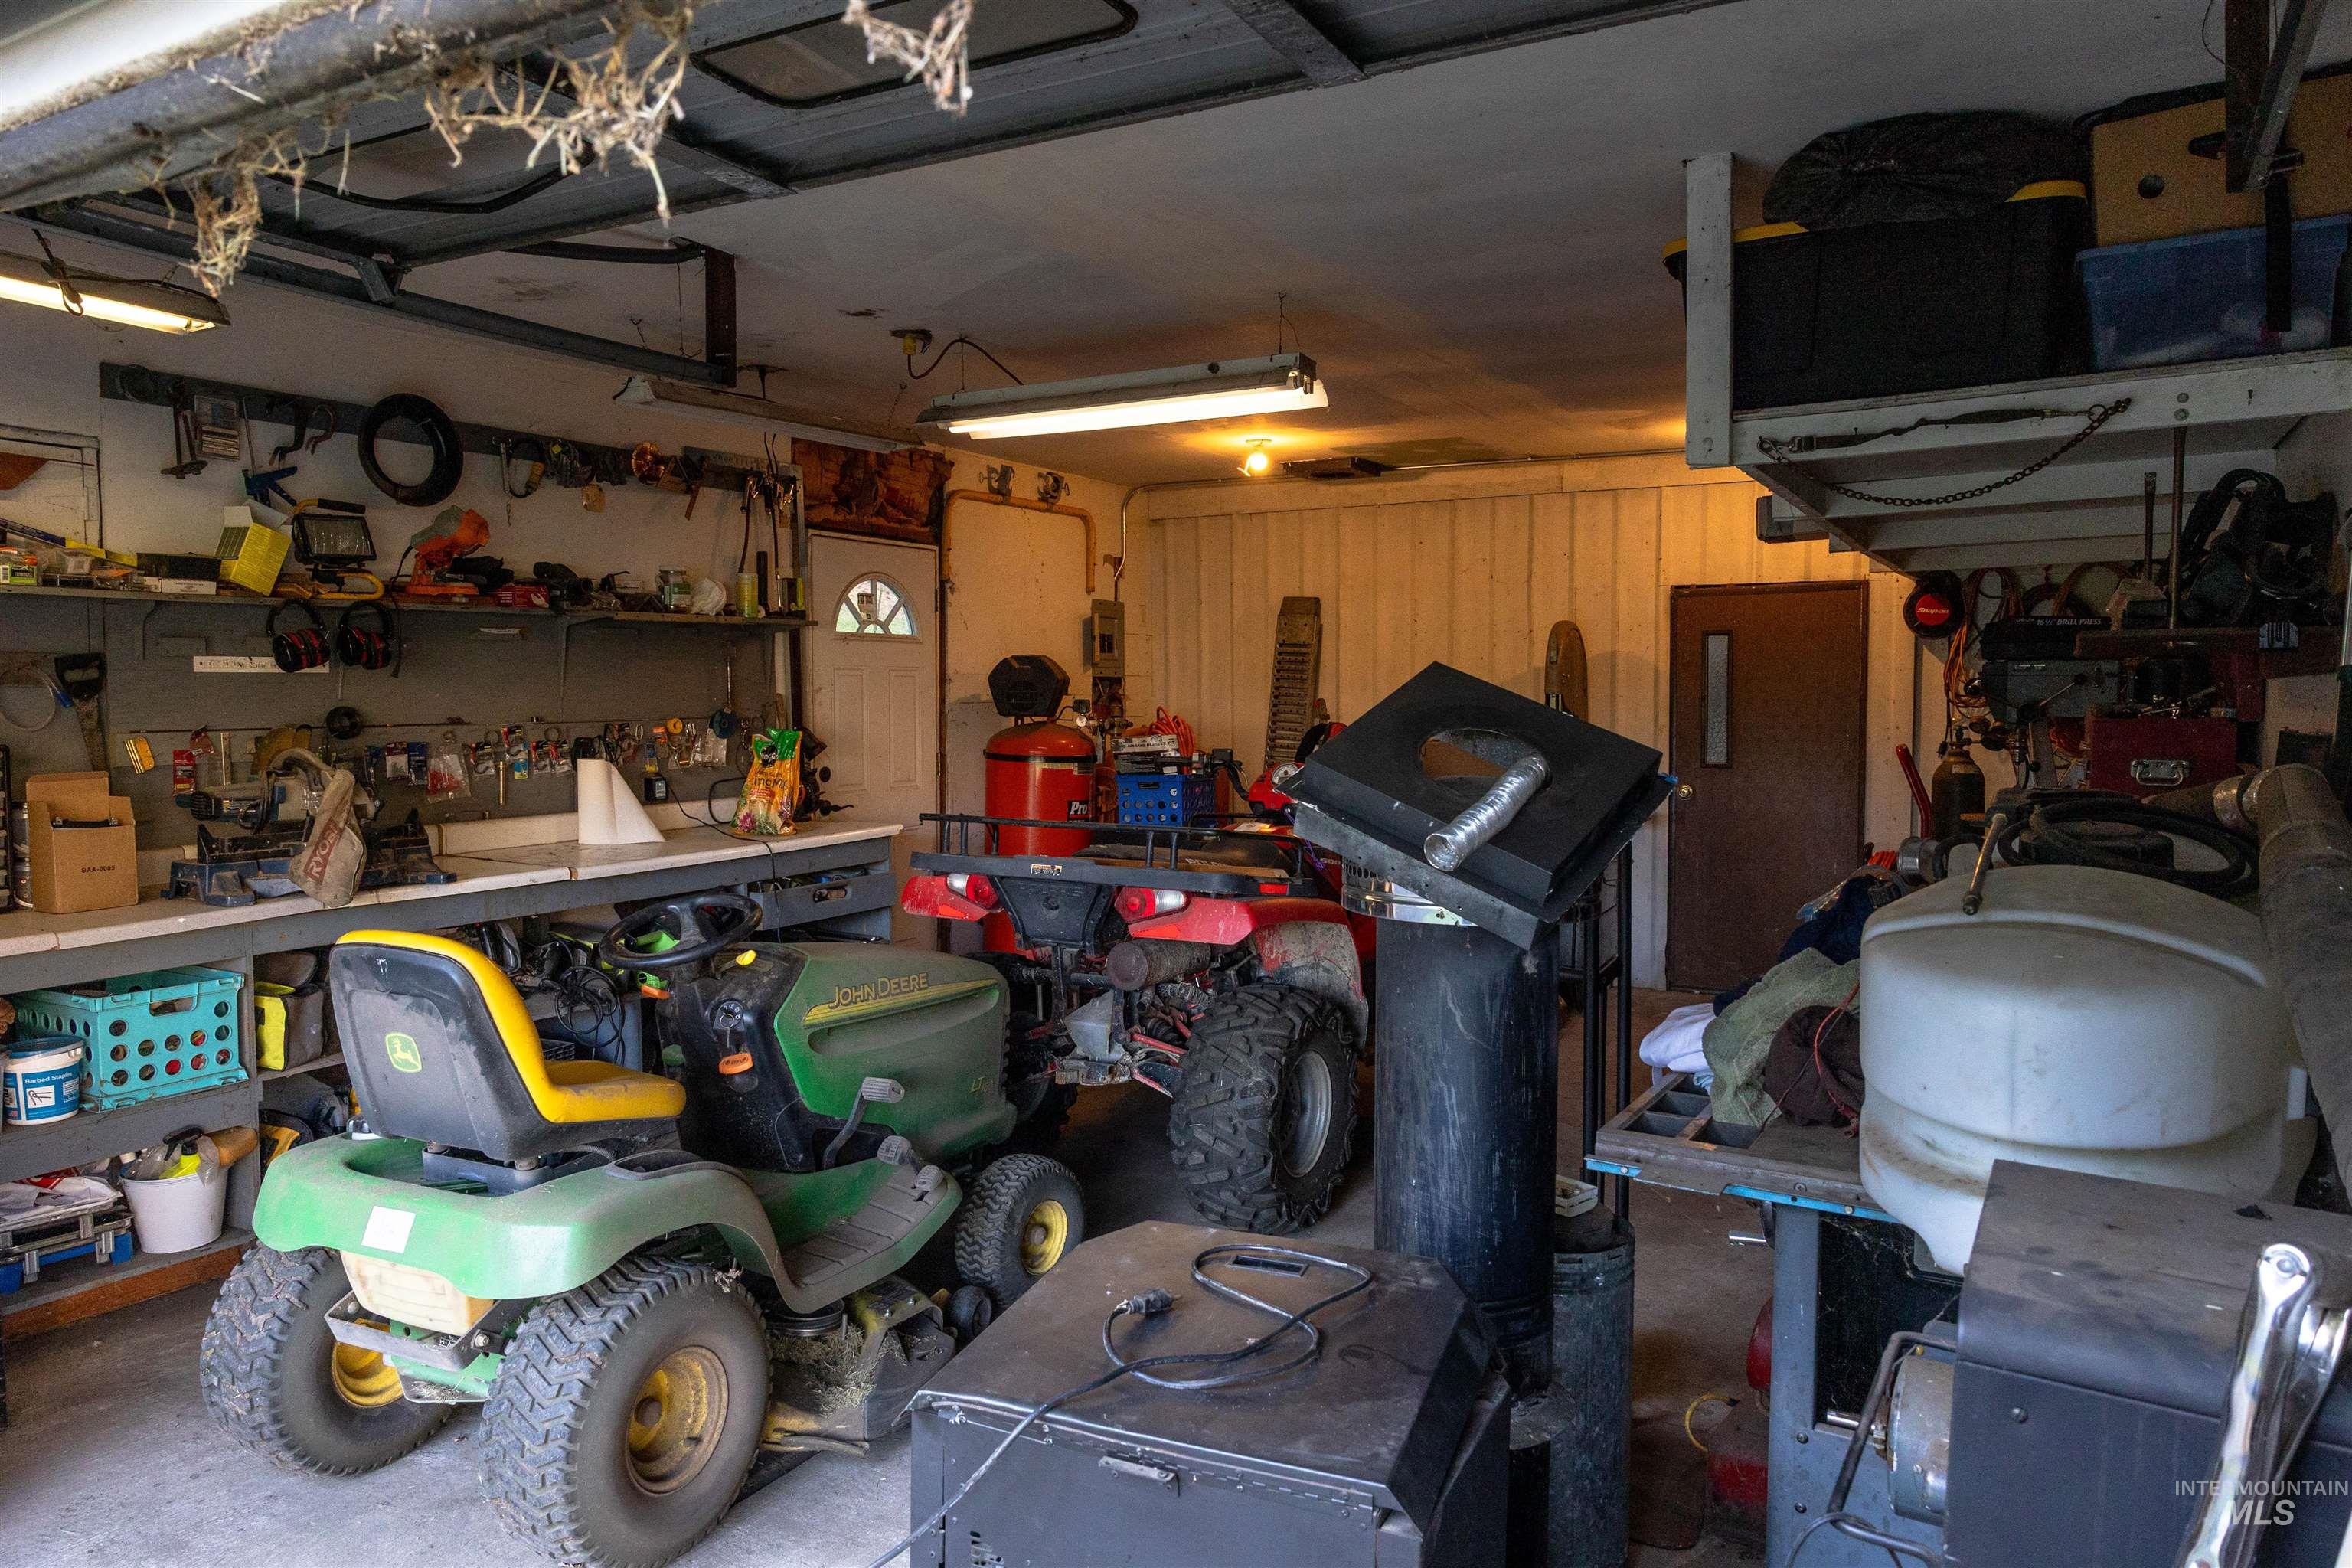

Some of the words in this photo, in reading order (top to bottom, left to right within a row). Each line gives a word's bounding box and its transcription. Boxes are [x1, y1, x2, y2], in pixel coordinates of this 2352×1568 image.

[828, 982, 875, 1009] JOHN
[877, 972, 929, 997] DEERE
[24, 1076, 51, 1084] Barbed
[51, 1072, 73, 1081] Staples
